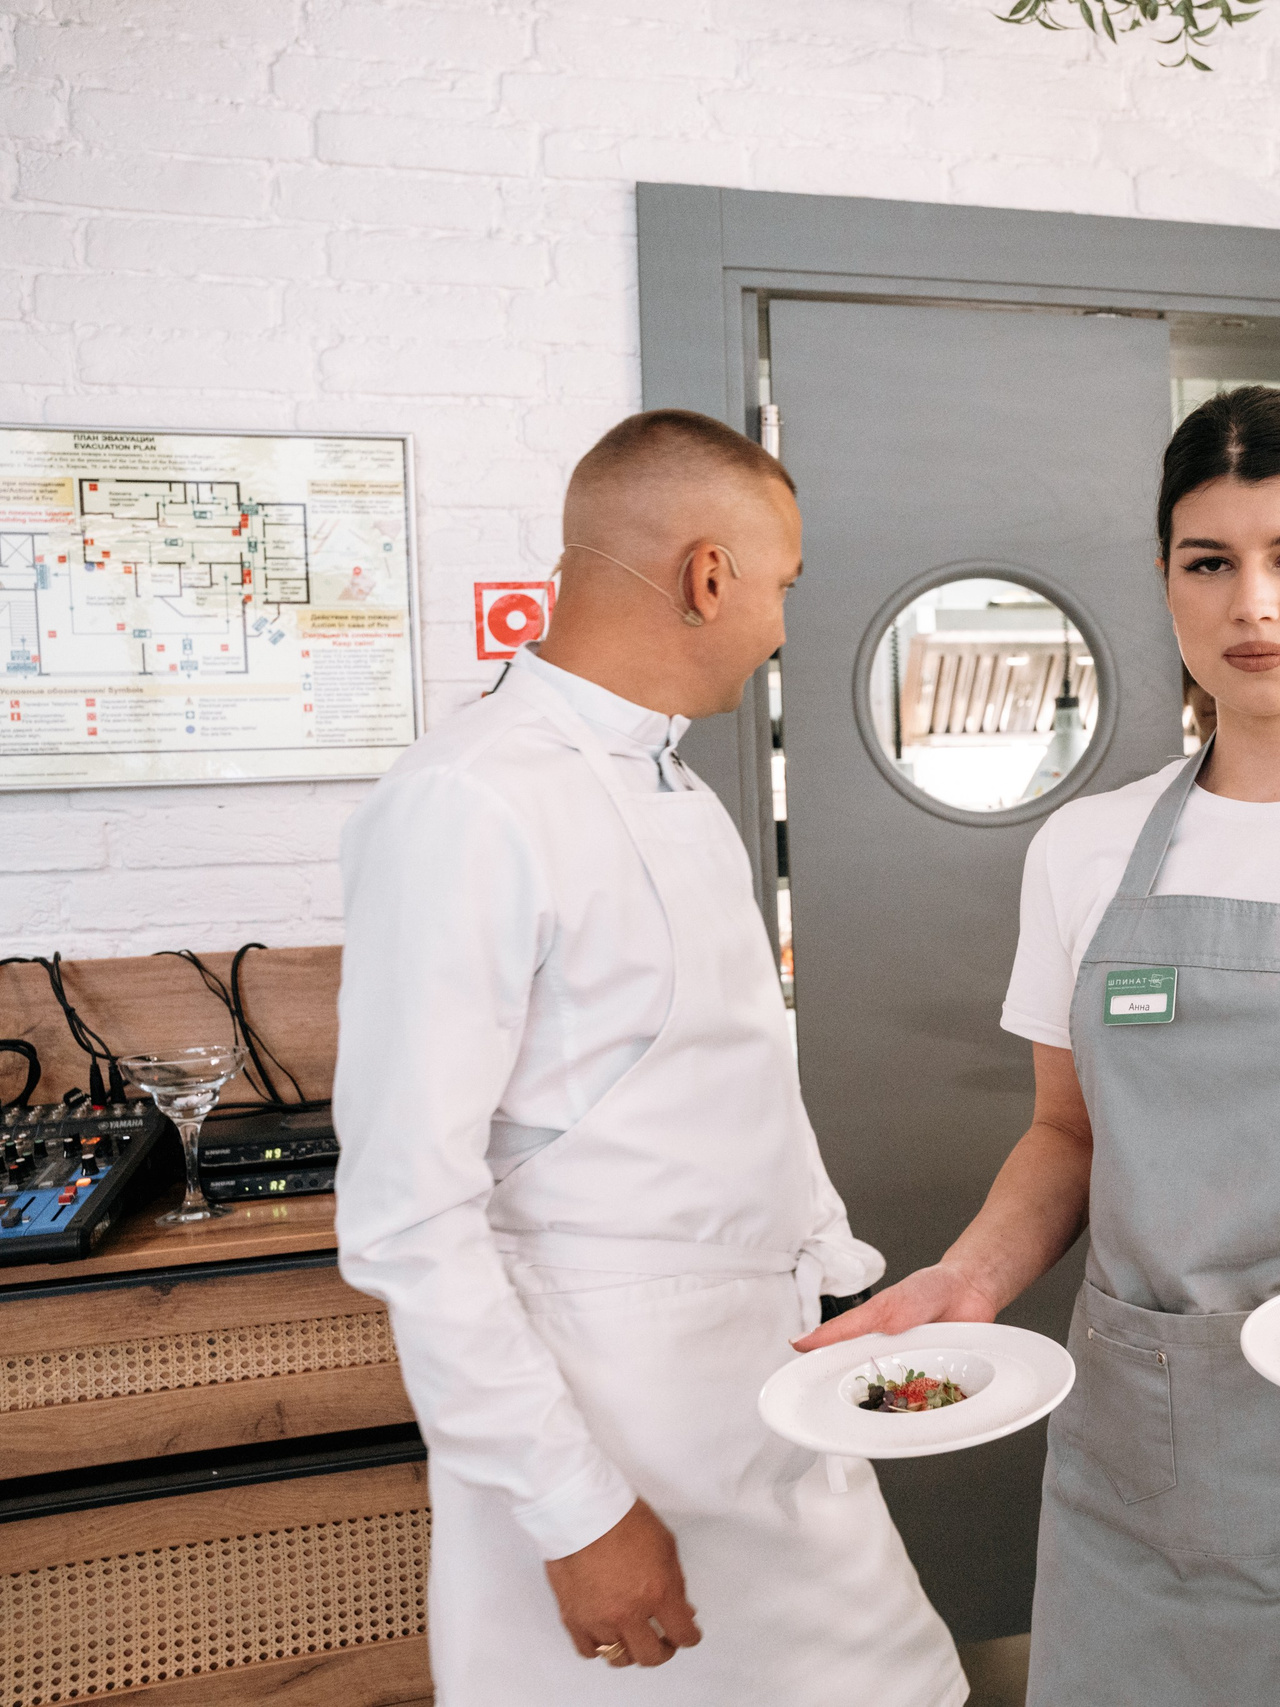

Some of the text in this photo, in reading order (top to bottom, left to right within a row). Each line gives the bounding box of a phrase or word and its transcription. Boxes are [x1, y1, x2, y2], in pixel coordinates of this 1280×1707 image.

[102, 435, 155, 443] ЭВАКУАЦИИ
[74, 443, 131, 451] EVACUATION
[1108, 977, 1147, 986] ШПИНАТ
[1128, 1002, 1151, 1011] Анна
[110, 1119, 144, 1129] YAMAHA
